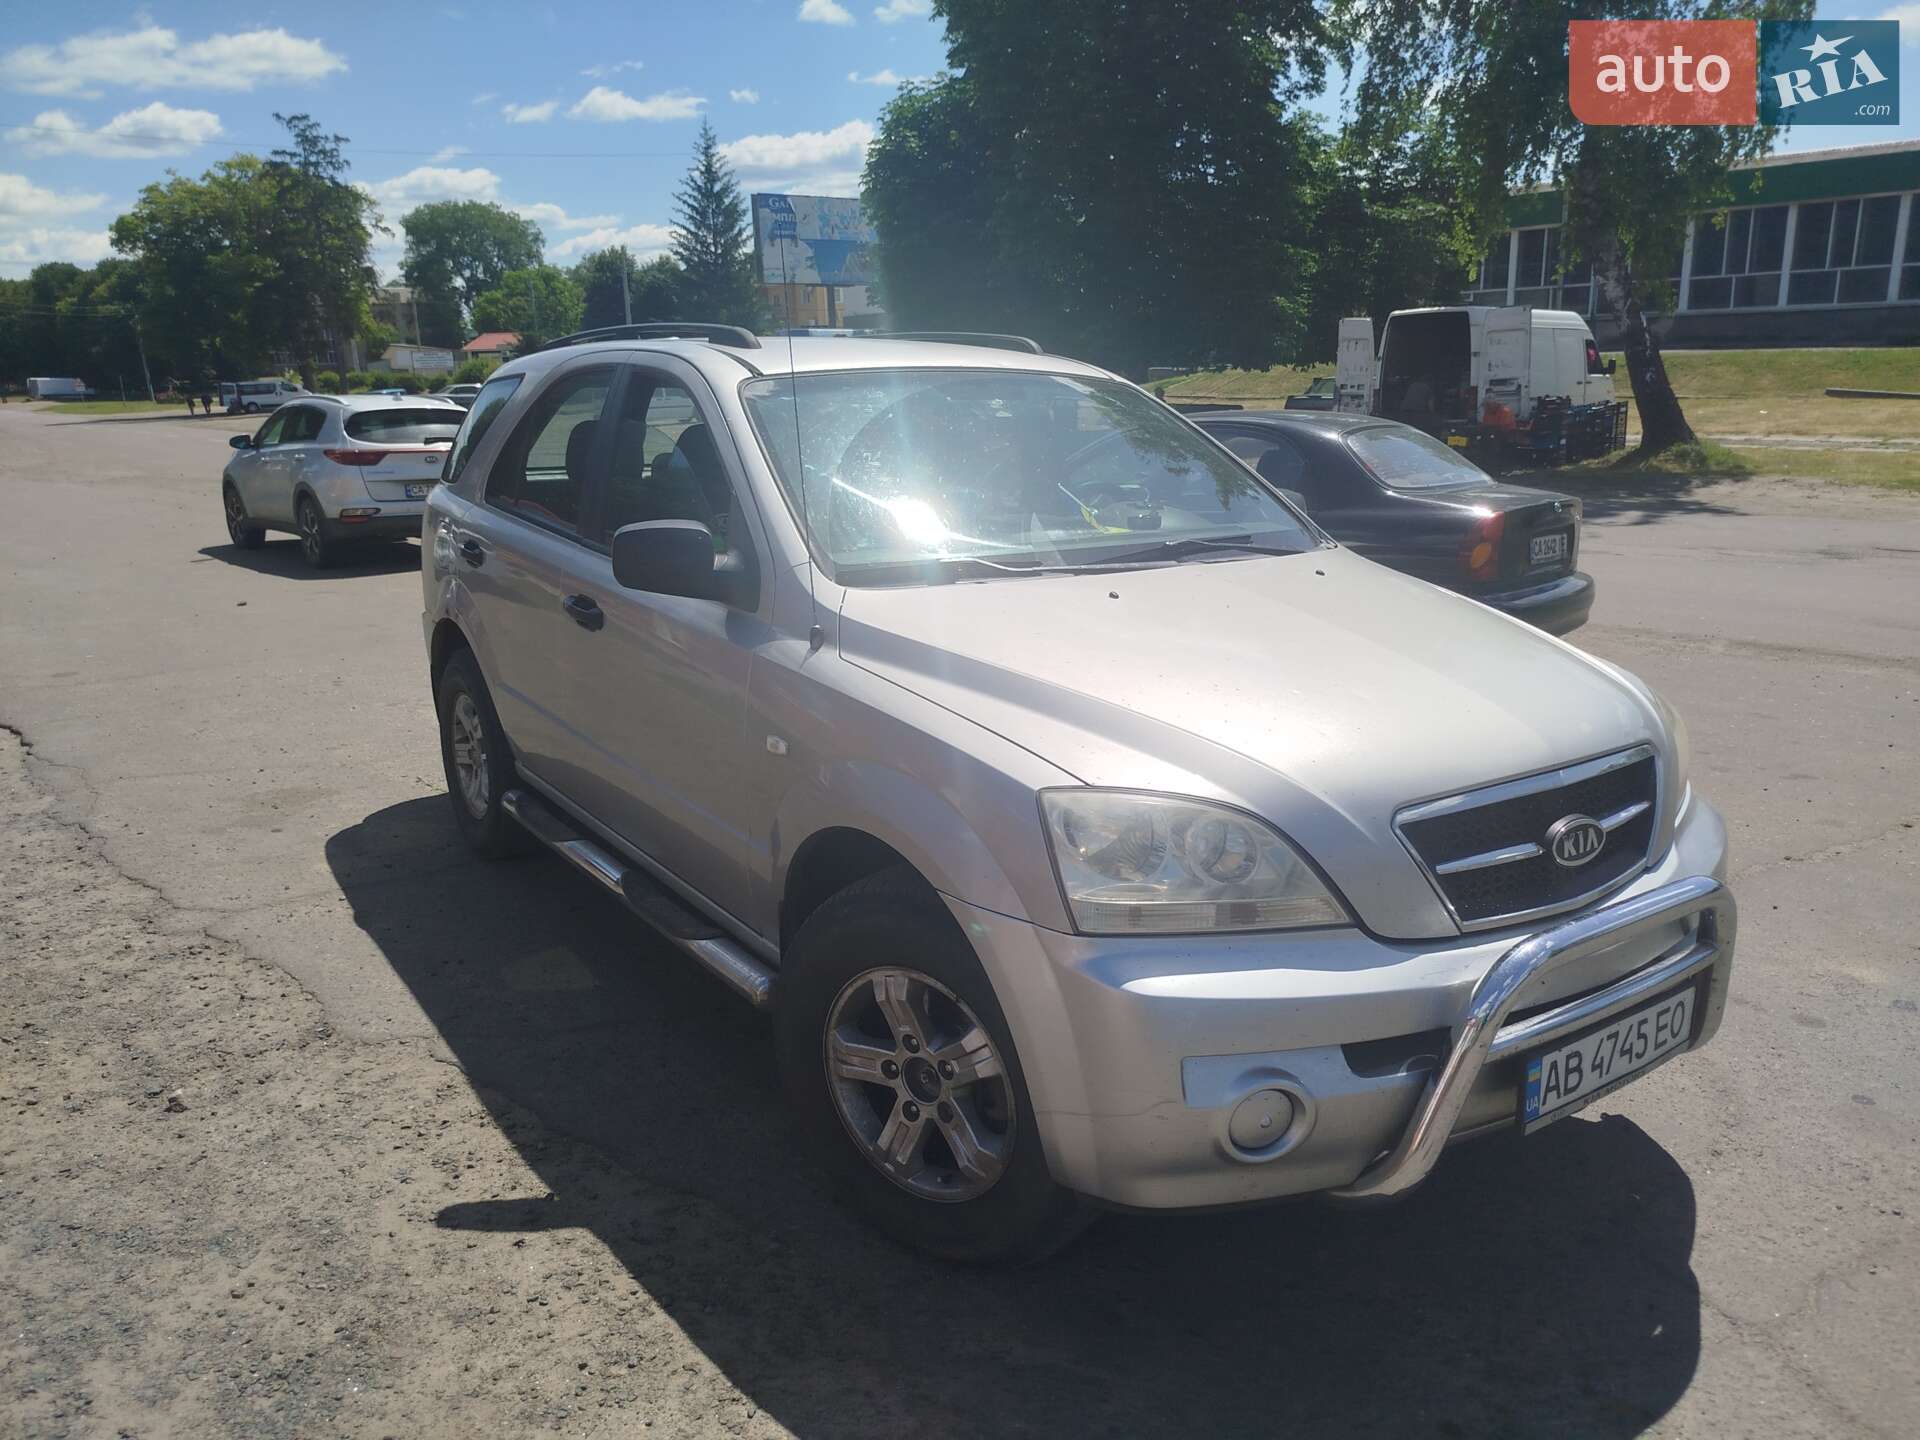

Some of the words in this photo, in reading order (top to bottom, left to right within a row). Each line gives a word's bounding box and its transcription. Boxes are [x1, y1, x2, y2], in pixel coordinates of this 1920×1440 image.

[1563, 827, 1598, 858] KIA
[1542, 1050, 1584, 1106] AB
[1591, 1018, 1649, 1079] 4745
[1526, 1099, 1540, 1112] UA
